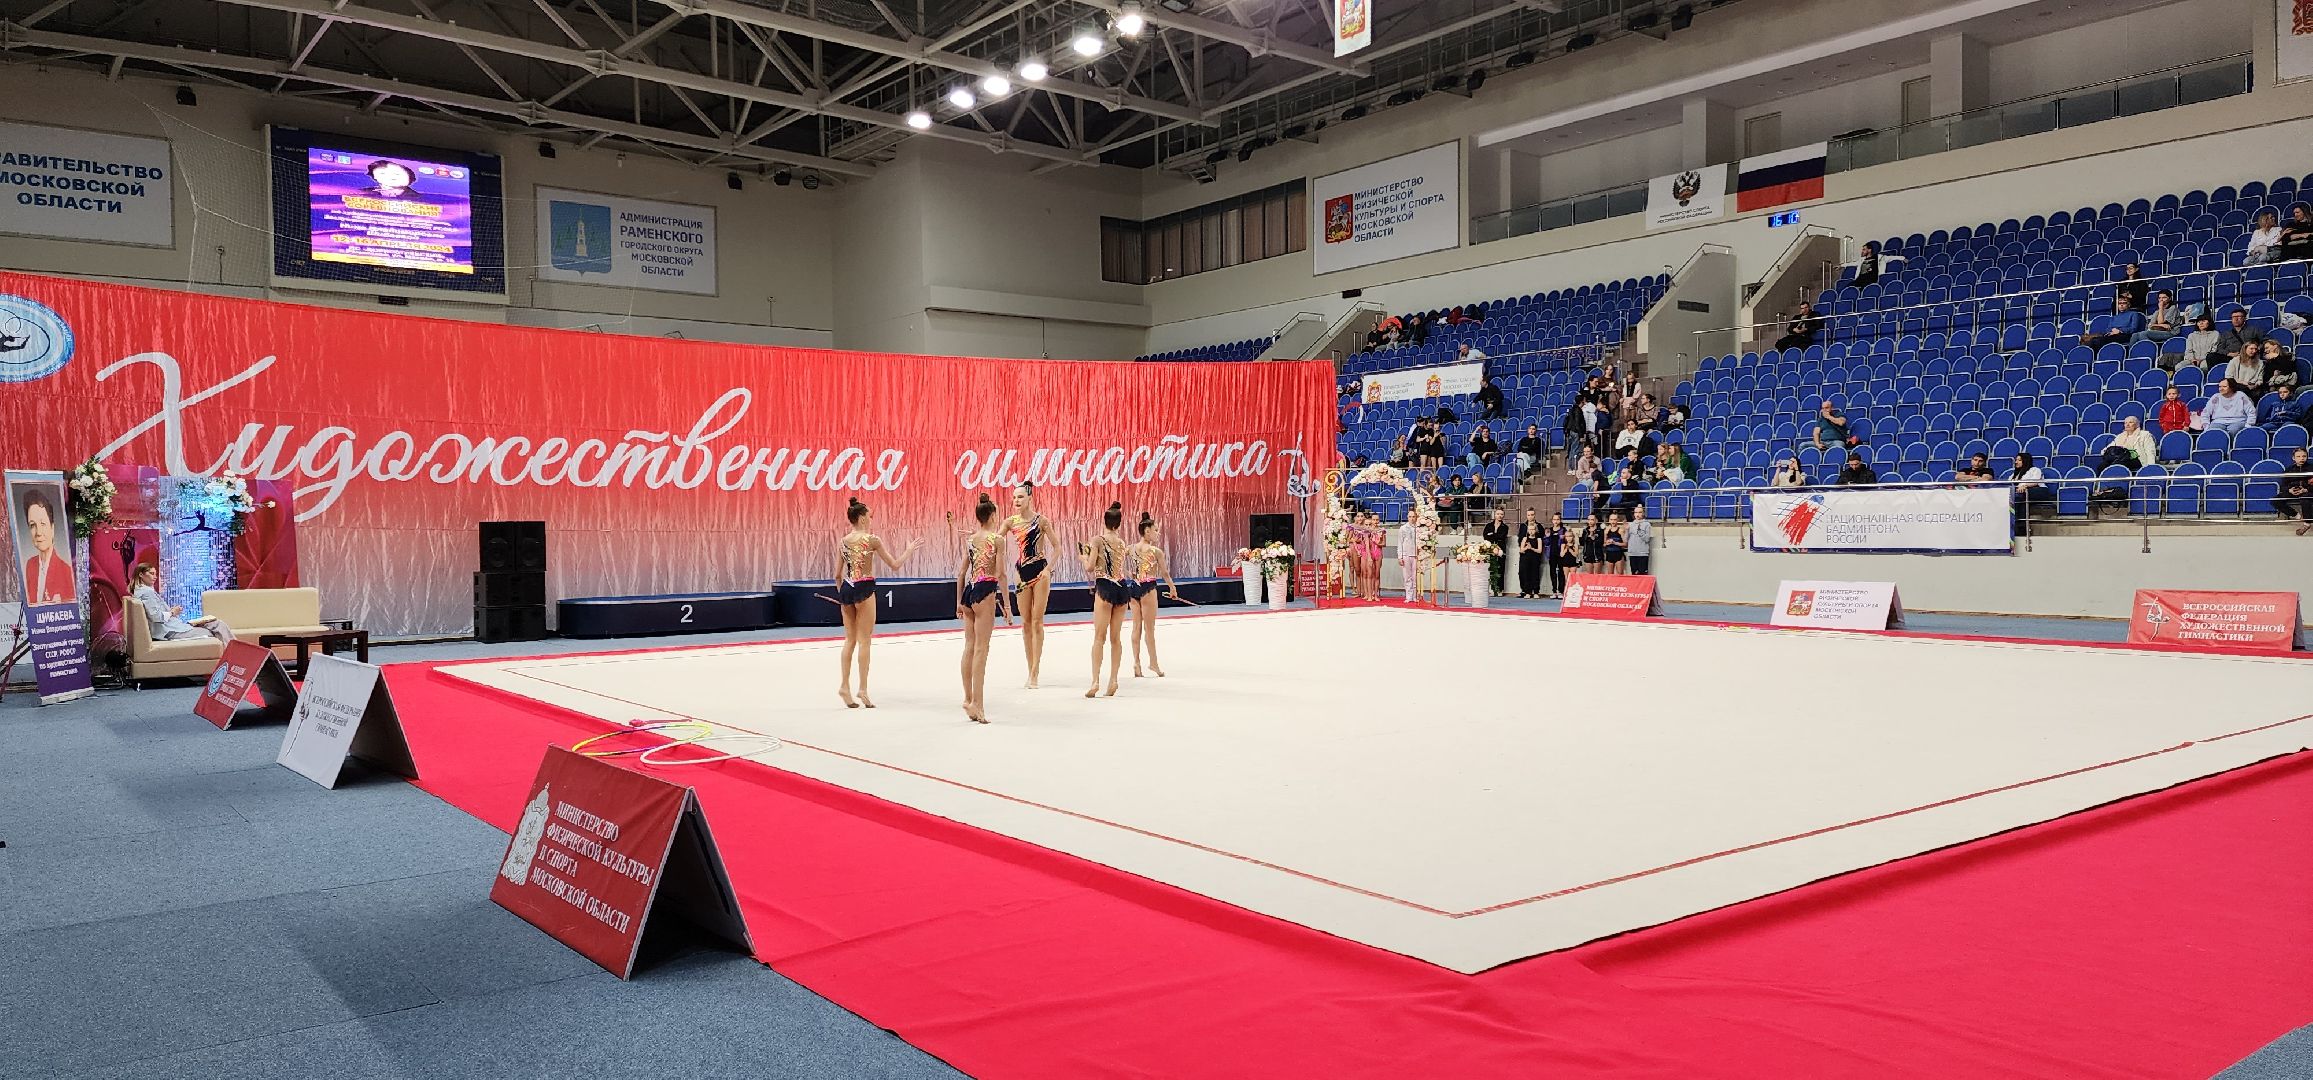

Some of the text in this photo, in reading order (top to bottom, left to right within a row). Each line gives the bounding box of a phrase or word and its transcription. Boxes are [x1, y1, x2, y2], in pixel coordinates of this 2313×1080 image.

[0, 152, 163, 180] АВИТЕЛЬСТВО
[1354, 176, 1424, 200] МИНИСТЕРСТВО
[17, 192, 122, 213] ОБЛАСТИ
[1354, 189, 1414, 211] ФИЗИЧЕСКОЙ
[1354, 193, 1444, 222] КУЛЬТУРЫ И СПОРТА
[620, 211, 703, 229] АДМИНИСТРАЦИЯ
[1354, 211, 1414, 232] МОСКОВСКОЙ
[620, 225, 703, 244] РАМЕНСКОГО
[1354, 227, 1394, 243] ОБЛАСТИ
[620, 240, 704, 257] ГОРОДСКОГО ОКРУГА
[631, 253, 694, 267] МОСКОВСКОЙ
[641, 265, 684, 277] ОБЛАСТИ
[94, 351, 1272, 522] Художественная гимнастика
[1827, 512, 1984, 525] НАЦИОНАЛЬНАЯ ФЕДЕРАЦИЯ
[1826, 524, 1900, 534] БАДМИНТОНА
[1826, 534, 1867, 544] РОССИИ
[884, 590, 893, 608] 1
[2182, 602, 2276, 613] ВСЕРОССИЙСКАЯ
[36, 609, 75, 624] ШИБАЕВА
[680, 604, 693, 623] 2
[2181, 612, 2248, 622] ФЕДЕРАЦИЯ
[2177, 631, 2254, 642] ГИМНАСТИКИ
[2179, 621, 2286, 634] ХУДОЖЕСТВЕННОЙ
[554, 800, 619, 842] МИНИСТЕРСТВО
[537, 844, 579, 877] И СПОРТА
[546, 822, 655, 887] ФИЗИЧЕСКОЙ КУЛЬТУРЫ
[529, 866, 631, 934] МОСКОВСКОЙ ОБЛАСТИ
